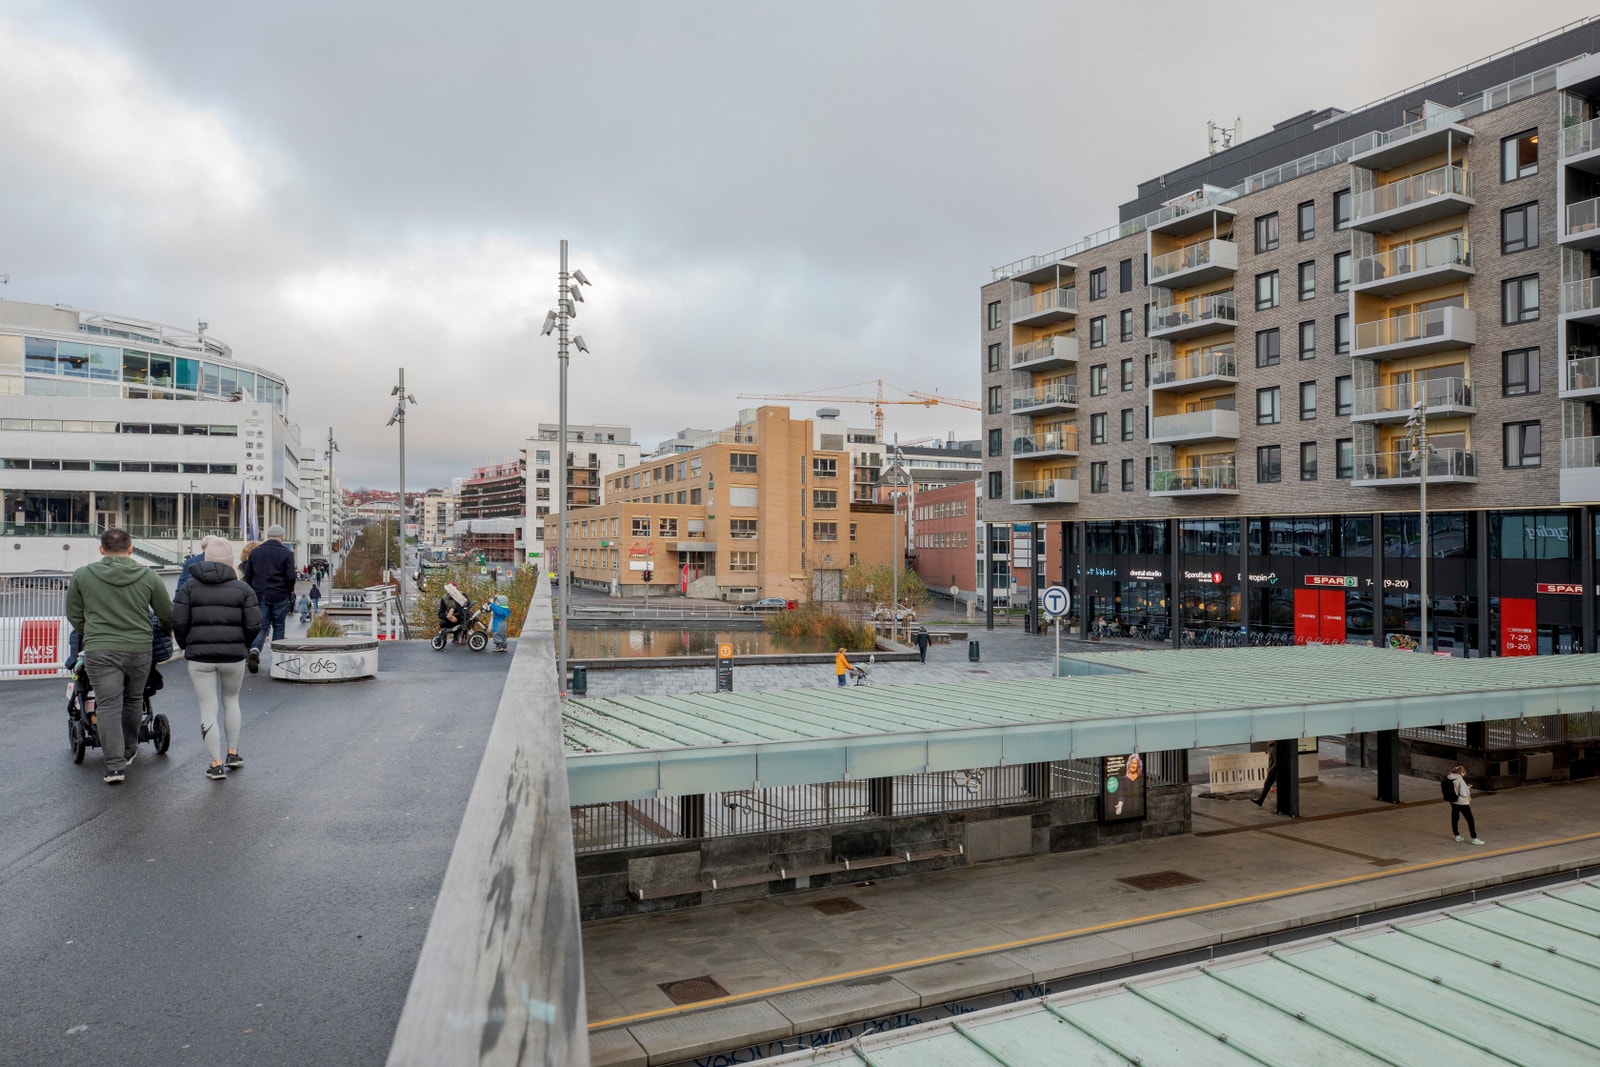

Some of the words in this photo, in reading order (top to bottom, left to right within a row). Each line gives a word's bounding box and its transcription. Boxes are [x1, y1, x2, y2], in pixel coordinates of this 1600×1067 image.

[1313, 577, 1345, 586] SPAR
[1383, 579, 1409, 589] (9-20)
[1547, 585, 1583, 593] SPAR
[1510, 633, 1529, 642] 7-22
[23, 646, 54, 655] AVIS
[1506, 642, 1531, 651] (9-20)
